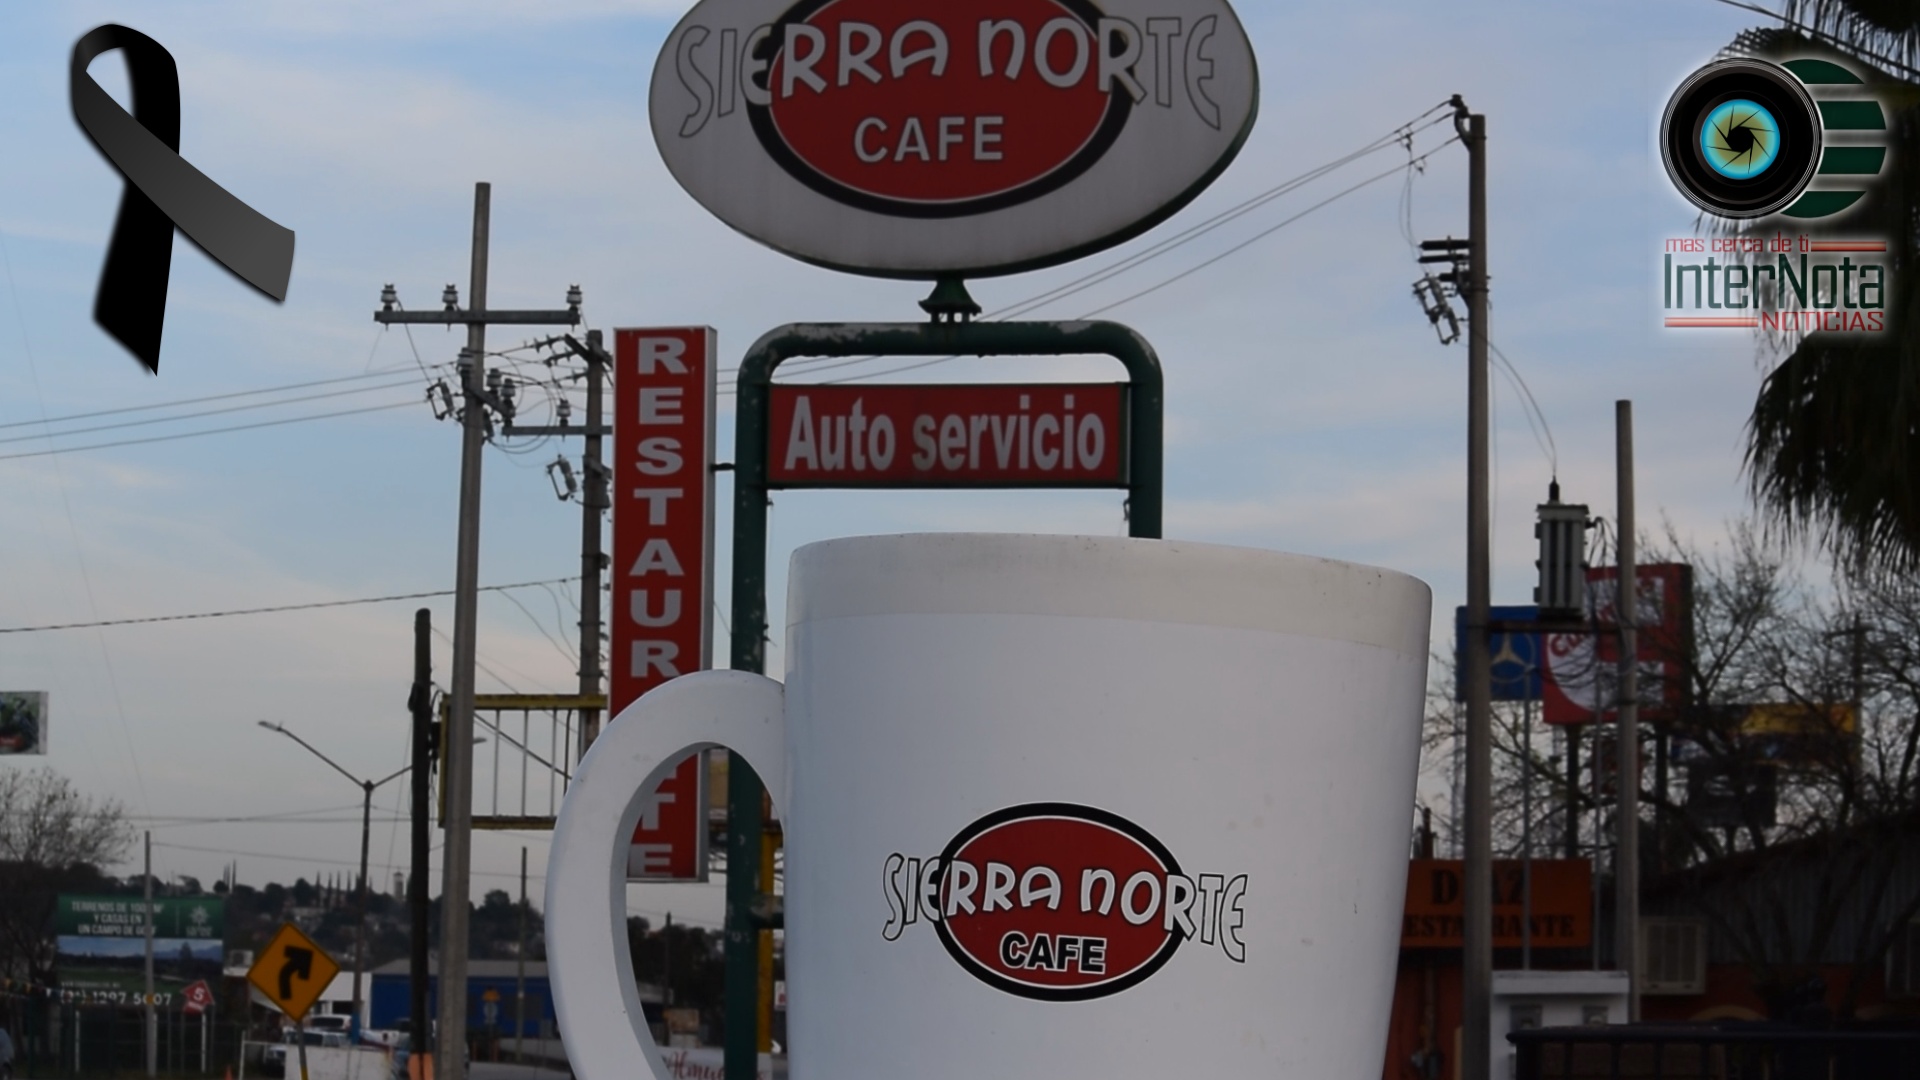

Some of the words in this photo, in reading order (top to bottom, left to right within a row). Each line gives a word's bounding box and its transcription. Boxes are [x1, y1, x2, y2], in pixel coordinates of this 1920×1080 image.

[675, 18, 949, 138] SIERRA
[978, 14, 1222, 131] NORTE
[853, 115, 1005, 162] CAFE
[783, 395, 897, 471] Auto
[911, 393, 1106, 472] servicio
[627, 335, 689, 877] RESTAURTE
[92, 924, 121, 935] CAMPO
[101, 914, 128, 924] CASAS
[881, 852, 1062, 942] SIERRA
[1079, 867, 1249, 964] NORTE
[999, 930, 1108, 975] CAFE
